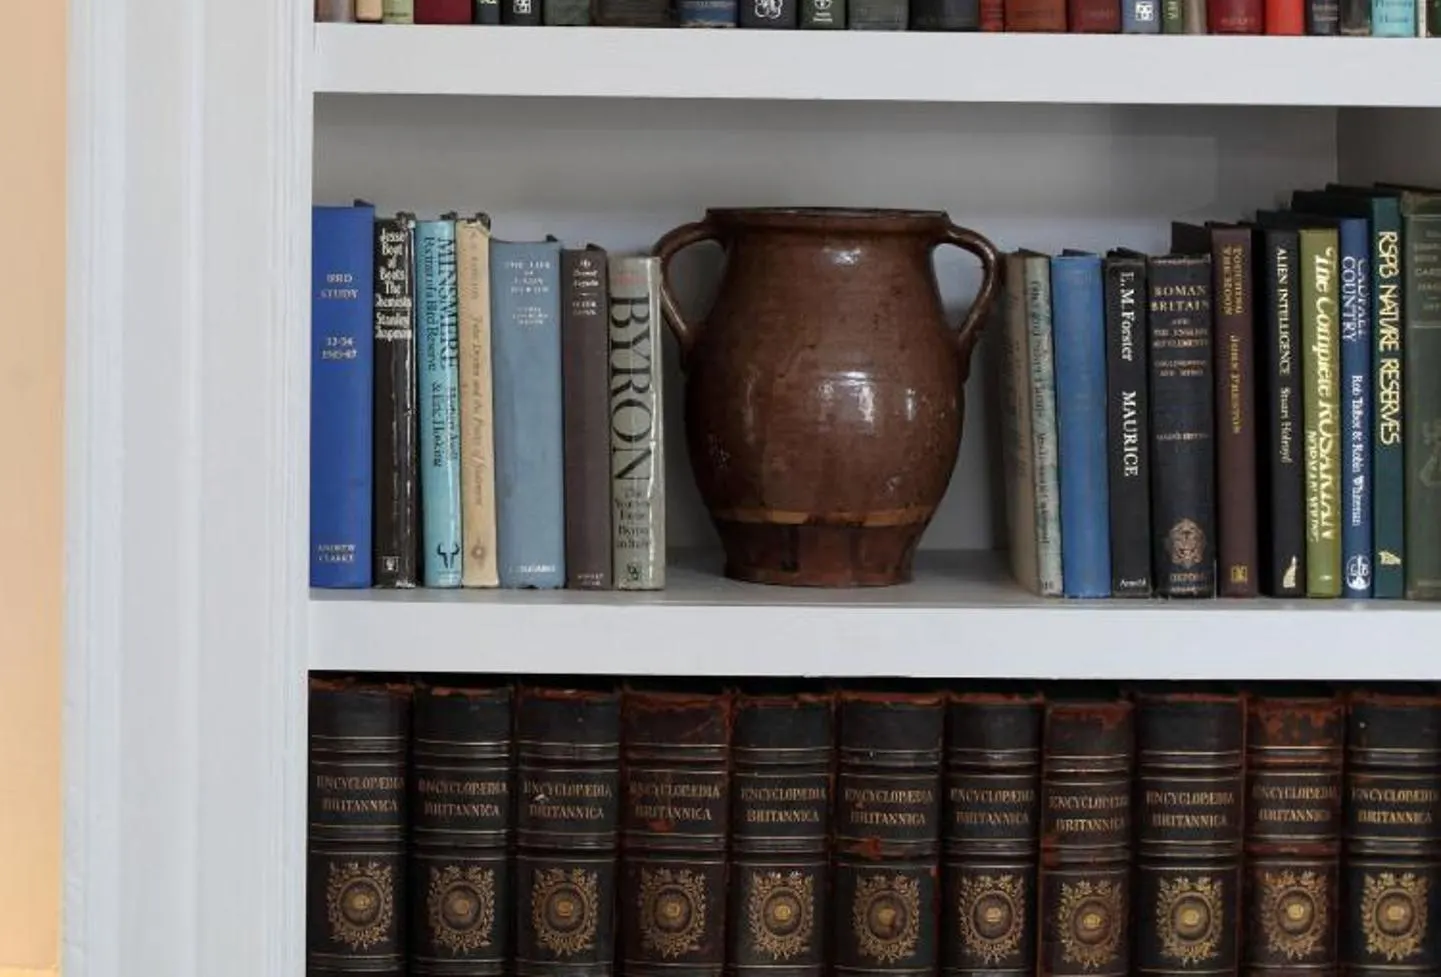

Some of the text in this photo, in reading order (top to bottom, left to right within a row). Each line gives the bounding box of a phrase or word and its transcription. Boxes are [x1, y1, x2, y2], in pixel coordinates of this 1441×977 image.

[382, 242, 403, 256] Boot
[1314, 246, 1338, 292] The
[385, 281, 401, 294] The
[1154, 285, 1207, 296] ROMAN
[438, 237, 459, 367] MINSMERE
[1151, 300, 1210, 312] BRITAIN
[1342, 255, 1358, 342] COUNTRY
[377, 311, 410, 326] Stanley
[427, 300, 440, 323] Bird
[1121, 310, 1135, 362] Forster
[1379, 231, 1401, 445] RSPB NATURE RESERVES
[427, 326, 439, 371] Reserve
[1312, 296, 1338, 396] Complete
[1276, 247, 1293, 464] ALIEN INTELLIGENCE Stuart Holroyd
[610, 292, 653, 481] BYRON
[1351, 374, 1364, 395] Rob
[1351, 398, 1364, 429] Talbot
[1122, 390, 1139, 477] MAURICE
[1352, 431, 1363, 441] &
[1352, 443, 1365, 472] Robin
[322, 798, 398, 813] BRITANNICA
[425, 802, 500, 817] BRITANNICA
[529, 805, 605, 820] BRITANNICA
[635, 806, 712, 821] BRITANNICA
[746, 809, 820, 823] BRITANNICA
[850, 811, 926, 825] BRITANNICA
[956, 811, 1030, 825] BRITANNICA
[1152, 814, 1227, 828] BRITANNICA
[1358, 810, 1433, 824] BRITANNICA
